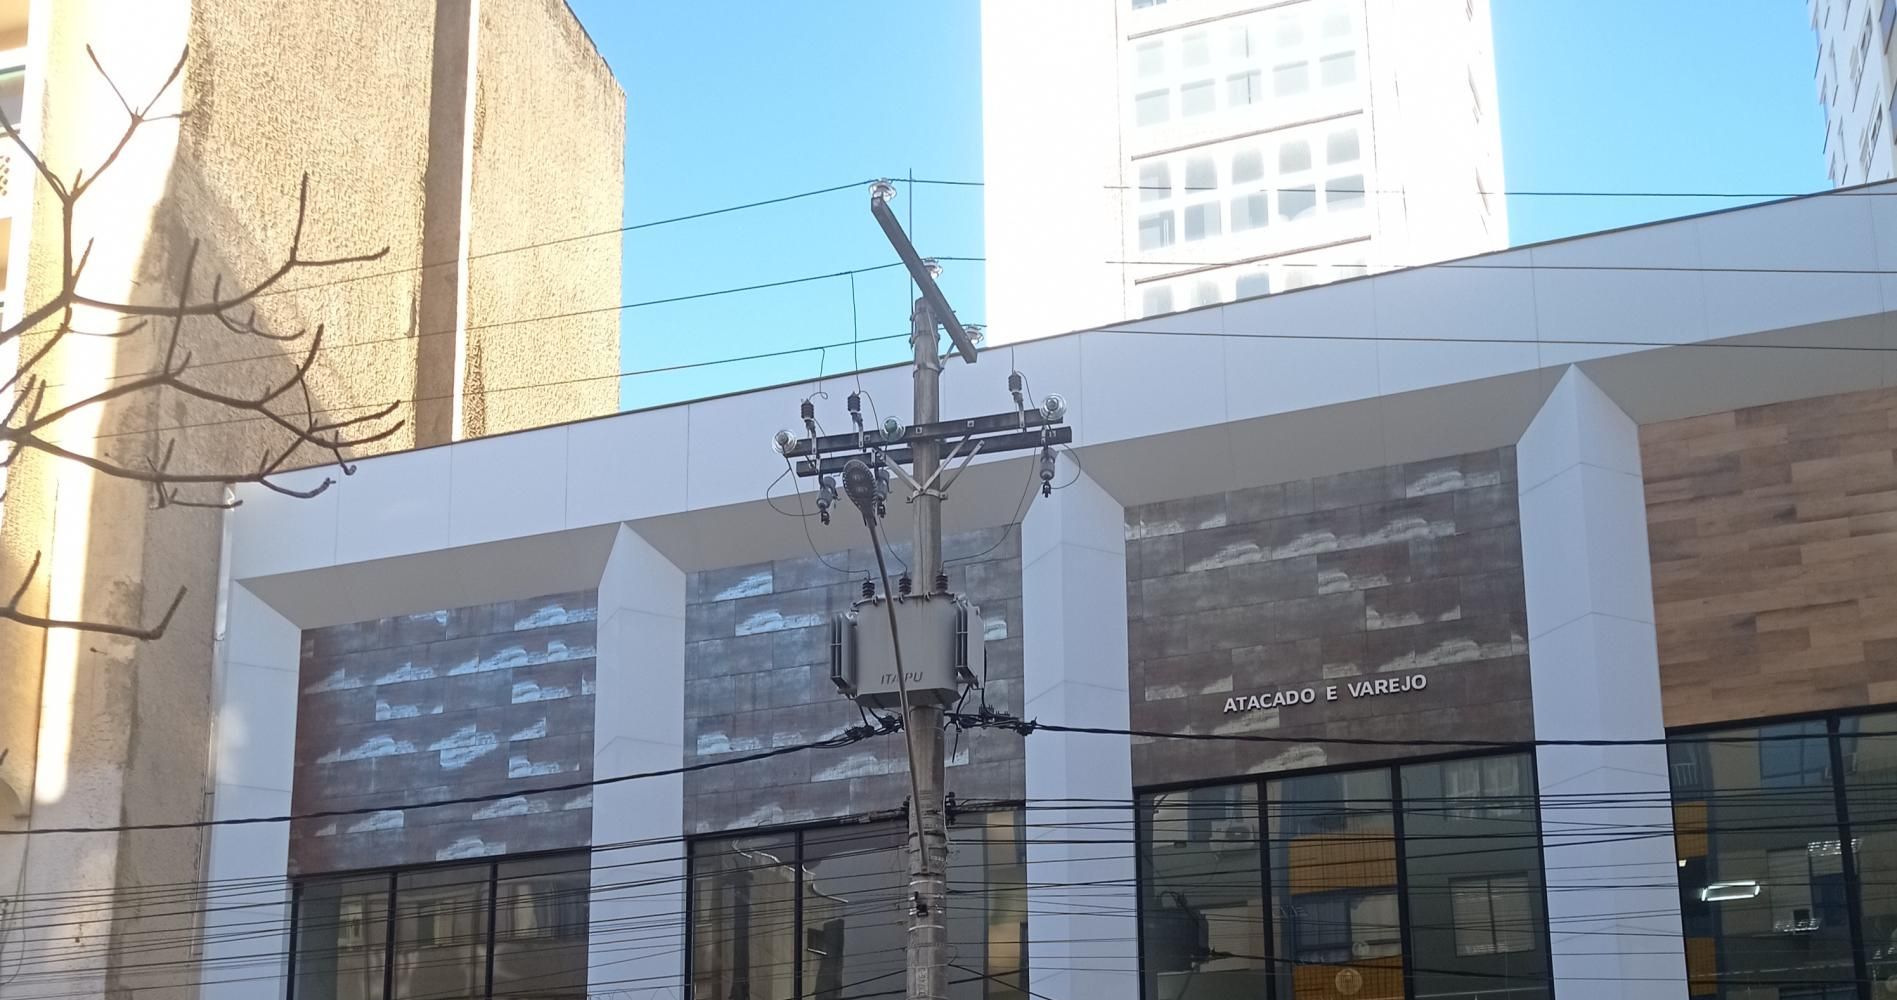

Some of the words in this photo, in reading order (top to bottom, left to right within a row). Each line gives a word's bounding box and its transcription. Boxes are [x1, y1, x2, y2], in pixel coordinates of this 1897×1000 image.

[880, 672, 924, 685] ITPU
[1223, 688, 1315, 713] ATACADO
[1326, 686, 1338, 700] E
[1348, 674, 1427, 698] VAREJO
